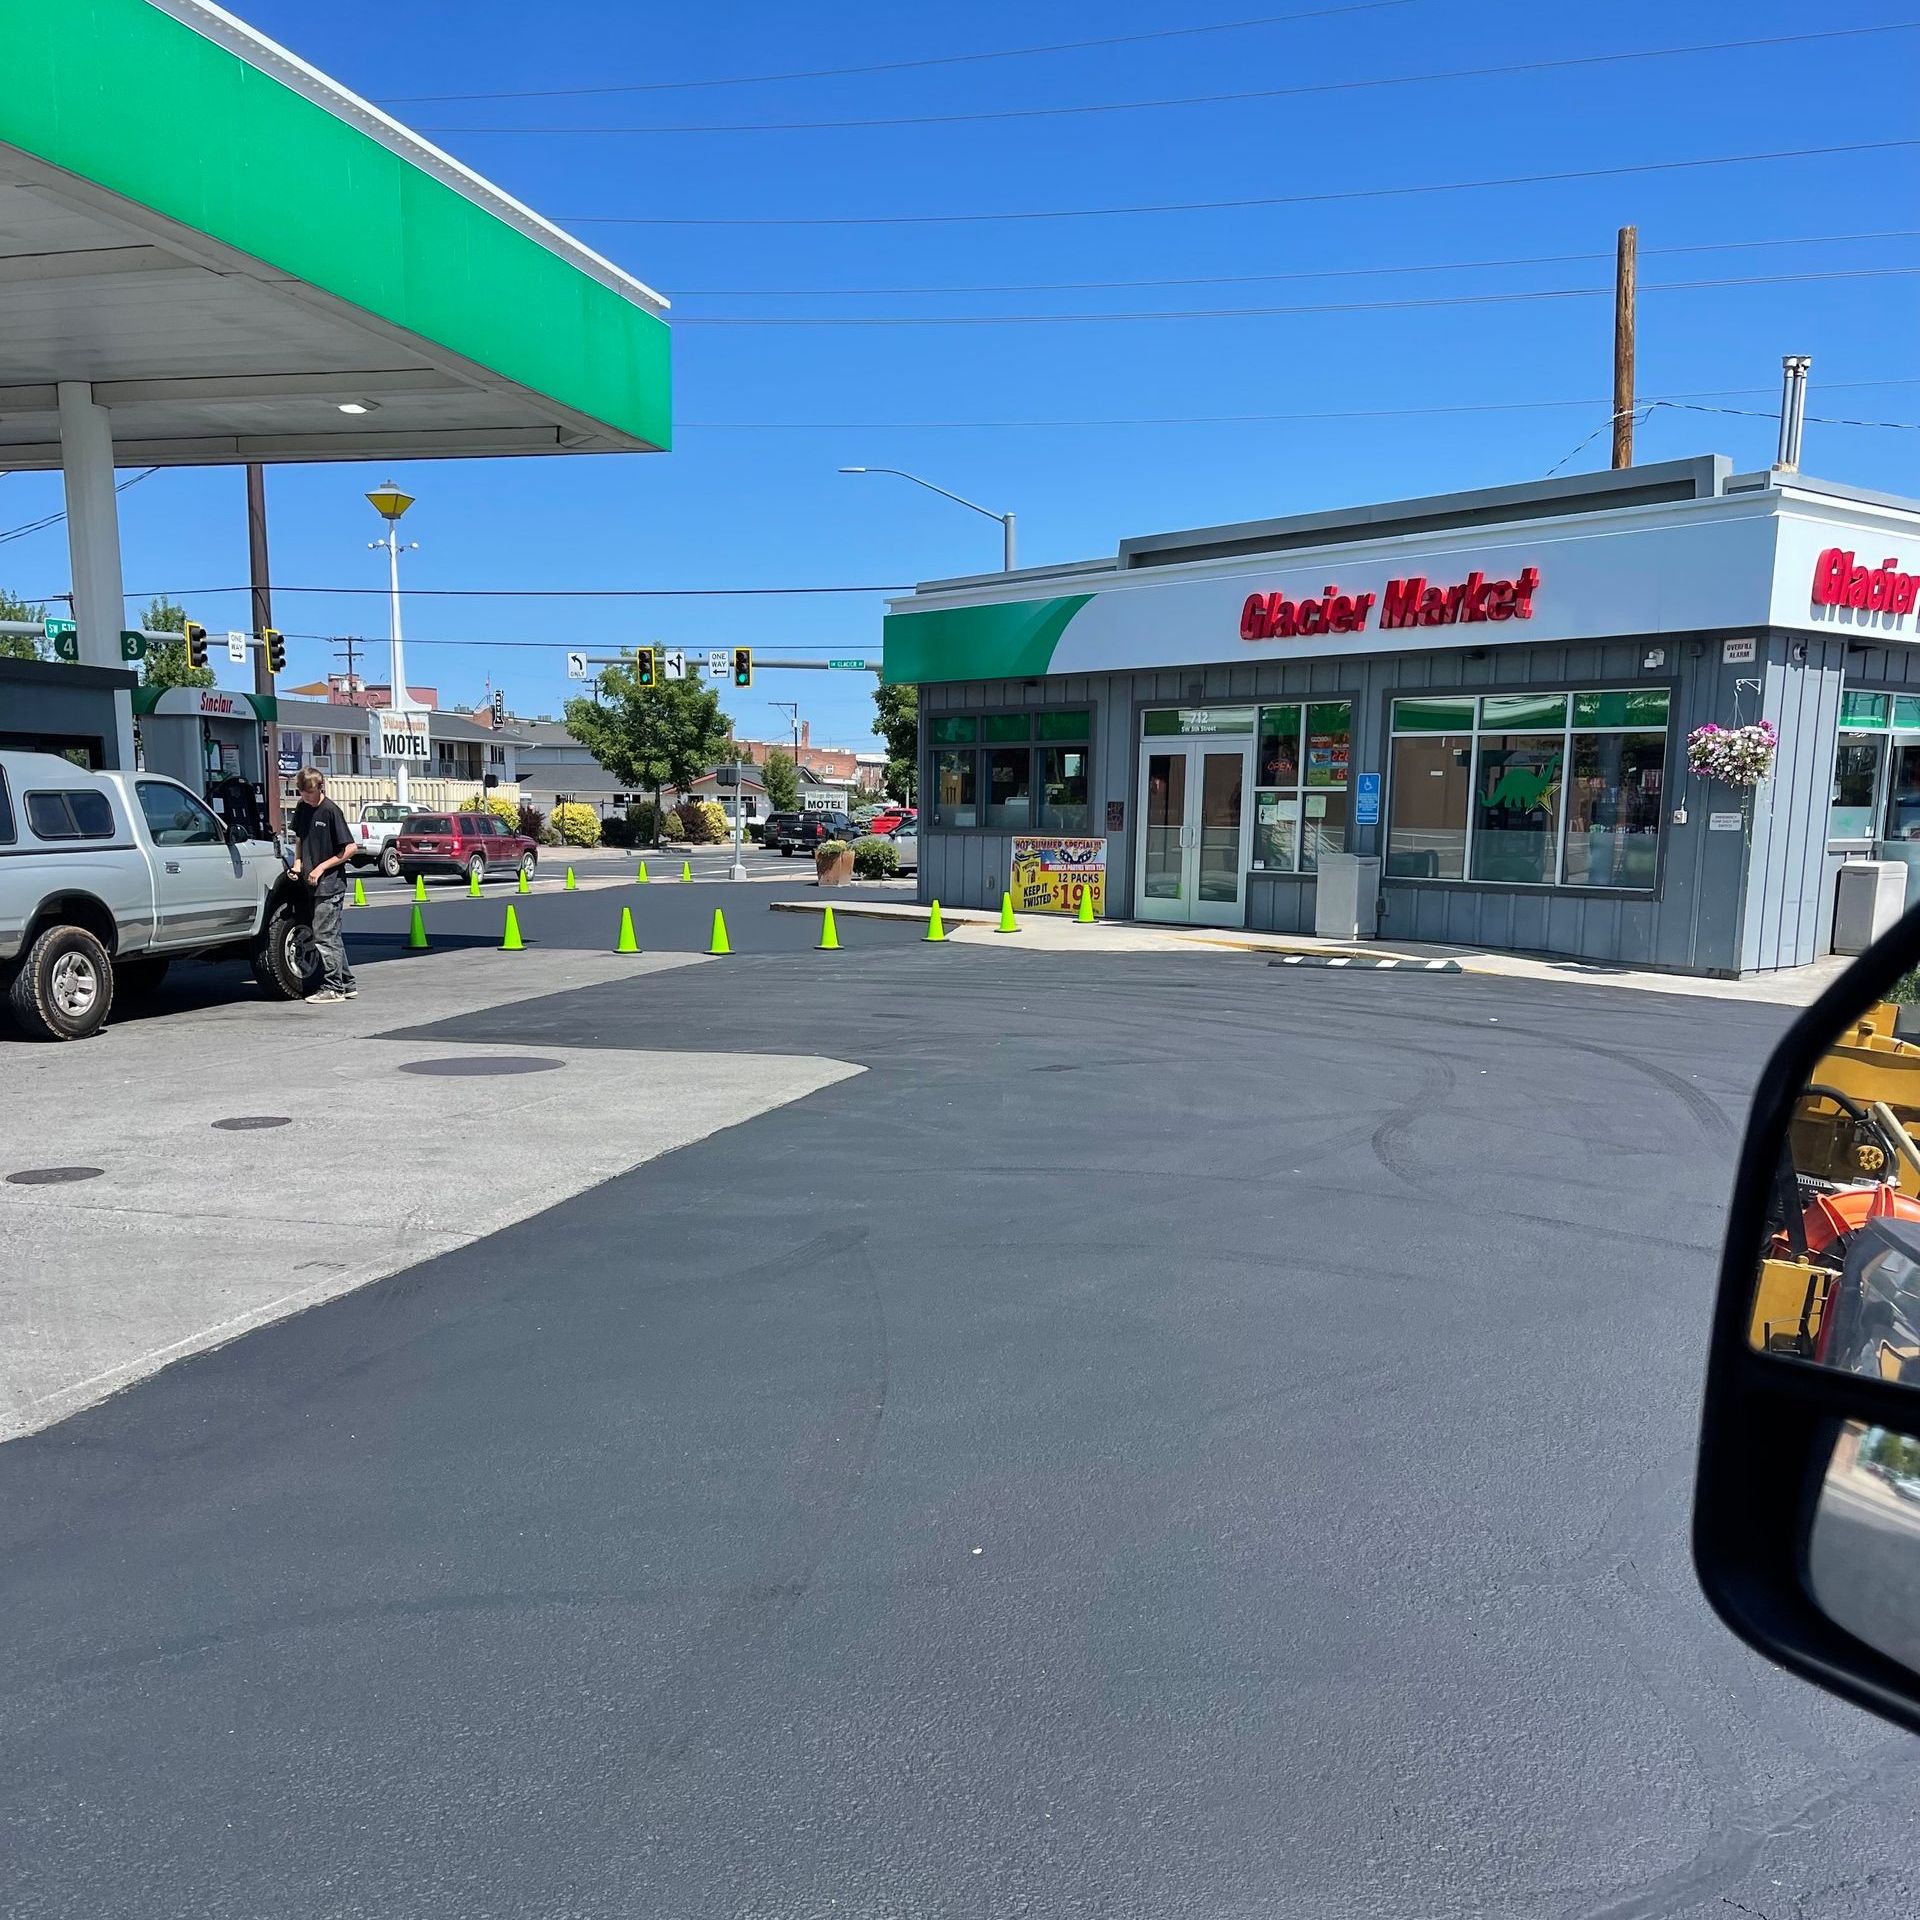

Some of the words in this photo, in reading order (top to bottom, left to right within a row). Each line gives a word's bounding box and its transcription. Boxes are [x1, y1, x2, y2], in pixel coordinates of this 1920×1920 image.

[1811, 547, 1920, 614] Glacier
[1239, 585, 1376, 641] Glacier
[1379, 567, 1540, 629] Market
[48, 624, 58, 634] SW
[127, 637, 138, 655] 3
[230, 634, 243, 643] ONE
[63, 637, 75, 656] 4
[200, 691, 233, 714] Sinclair
[1190, 711, 1209, 724] 712
[383, 734, 427, 755] MOTEL
[1267, 760, 1293, 772] OPEN
[807, 800, 843, 810] MOTEL
[1015, 840, 1030, 850] HOT
[1031, 839, 1062, 850] SUMMER
[1058, 873, 1068, 883] 12
[1071, 873, 1099, 883] PACKS
[1023, 884, 1041, 898] KEEP
[1041, 883, 1049, 894] IT
[1023, 893, 1052, 909] TWISTED
